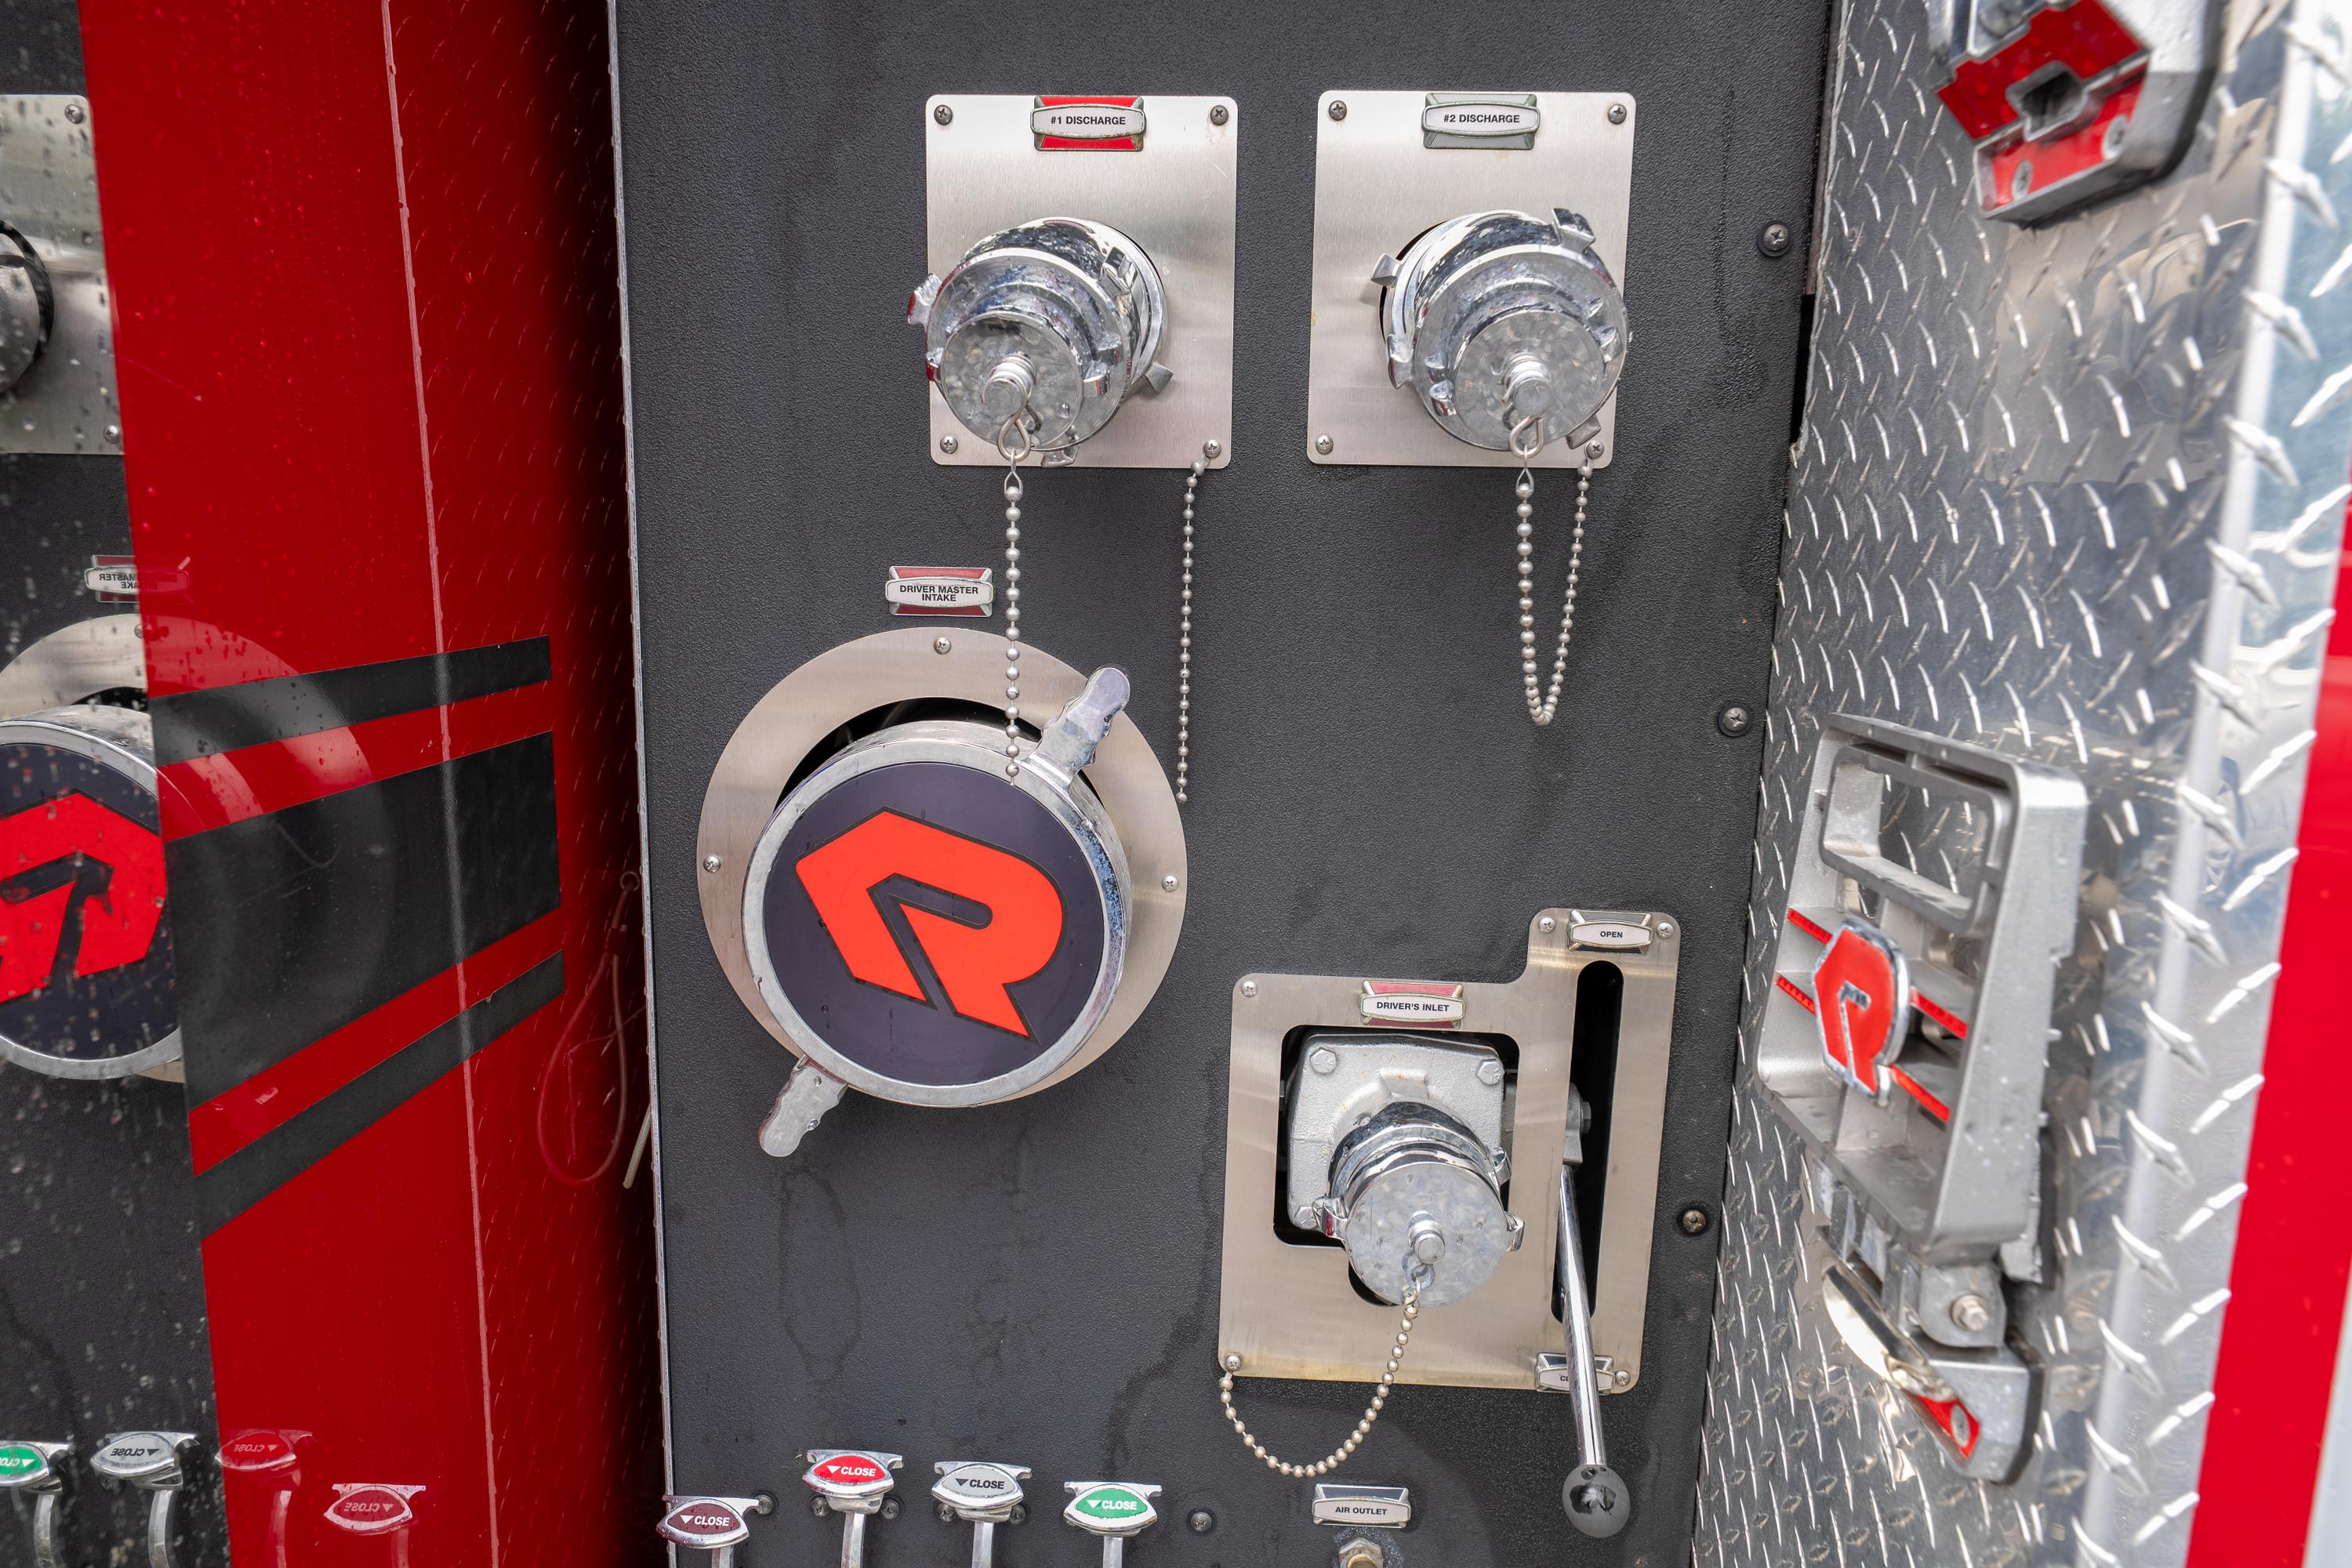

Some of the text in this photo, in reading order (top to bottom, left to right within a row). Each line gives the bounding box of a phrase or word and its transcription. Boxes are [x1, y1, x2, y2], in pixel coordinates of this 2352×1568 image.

[1051, 116, 1126, 125] #1 DISCHARGE
[1444, 114, 1520, 123] #2 DISCHARGE
[900, 585, 978, 594] DRIVER MASTER
[1376, 1001, 1450, 1012] DRIVER'S INLET
[840, 1465, 877, 1478] CLOSE
[969, 1479, 1005, 1490] CLOSE
[1101, 1499, 1138, 1511] CLOSE
[1352, 1507, 1388, 1515] OUTLET
[693, 1515, 731, 1527] CLOSE
